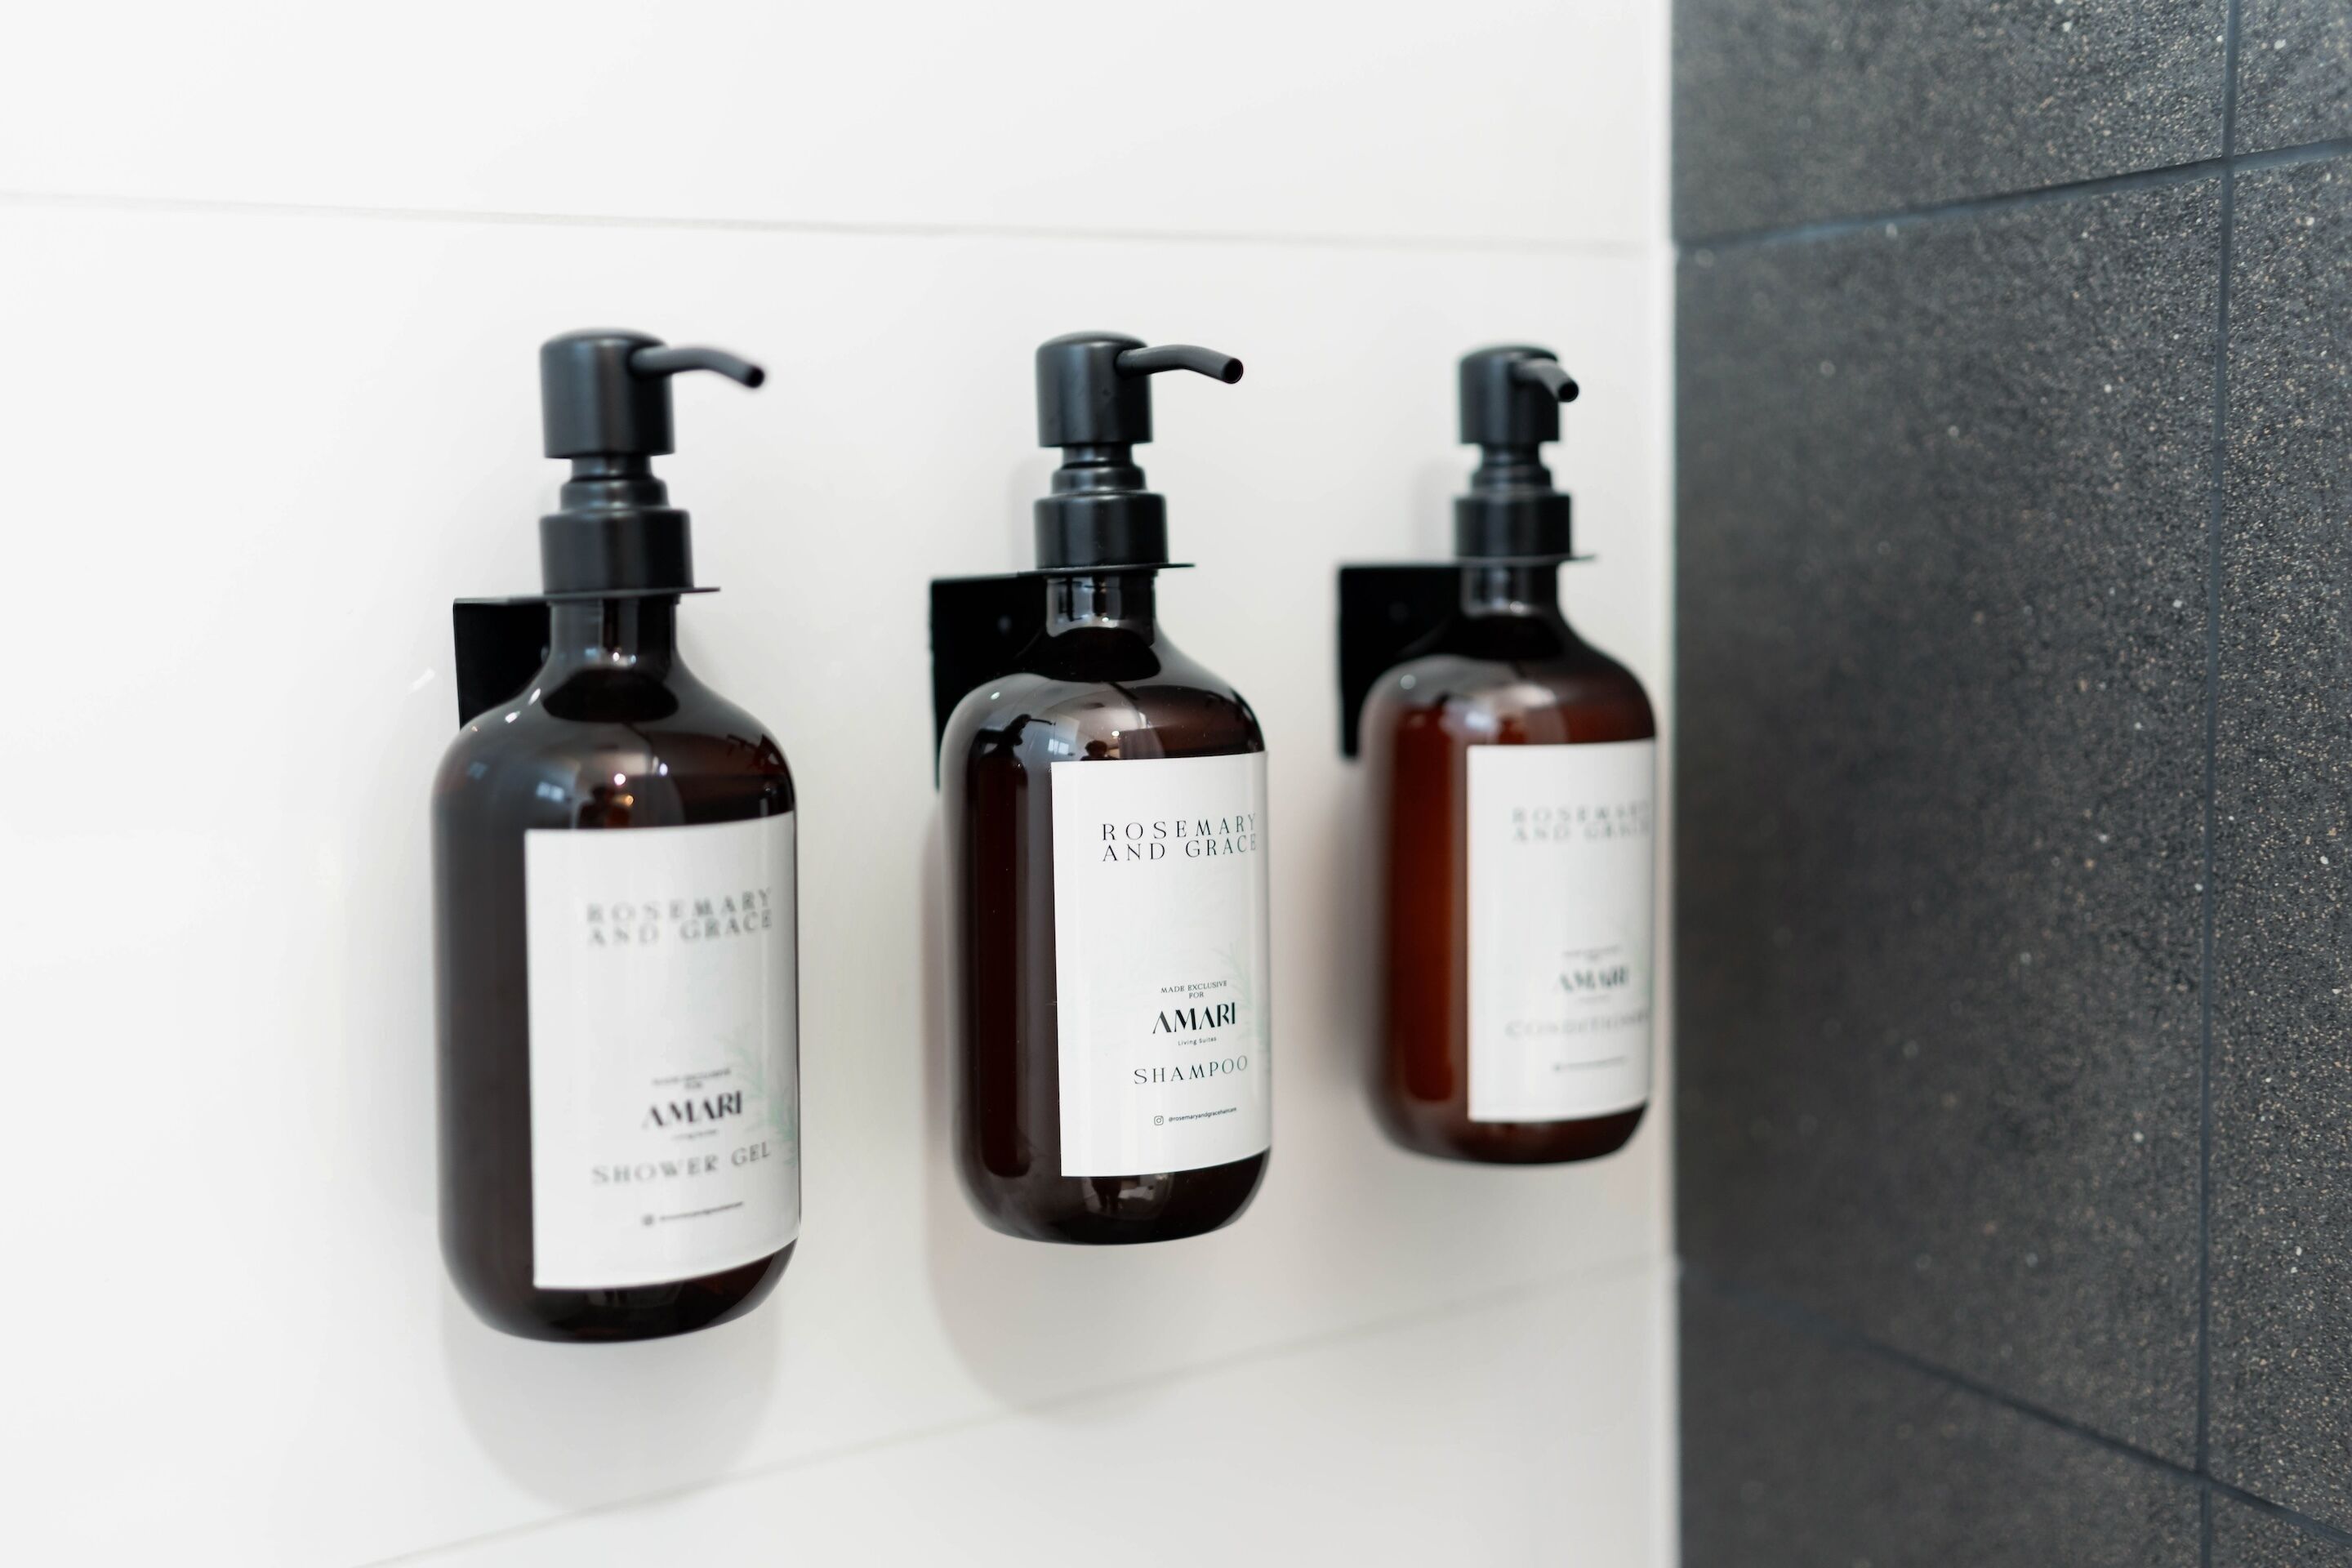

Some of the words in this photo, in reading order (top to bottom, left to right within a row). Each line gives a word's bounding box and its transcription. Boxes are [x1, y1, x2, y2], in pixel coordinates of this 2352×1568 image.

[1102, 813, 1256, 841] ROSEMARY
[1102, 843, 1165, 862] AND
[1186, 833, 1257, 858] GRACE
[586, 887, 772, 924] ROSEMARY
[587, 922, 659, 947] AND
[679, 909, 773, 942] GRACE
[1160, 985, 1185, 994] MADE
[1187, 980, 1227, 991] EXCLUSIVE
[1188, 991, 1205, 1000] FOR
[1152, 1001, 1236, 1035] AMARI
[1134, 1055, 1248, 1085] SHAMPOO
[641, 1089, 742, 1129] AMARI
[591, 1154, 719, 1184] SHOWER
[730, 1141, 771, 1167] GEL
